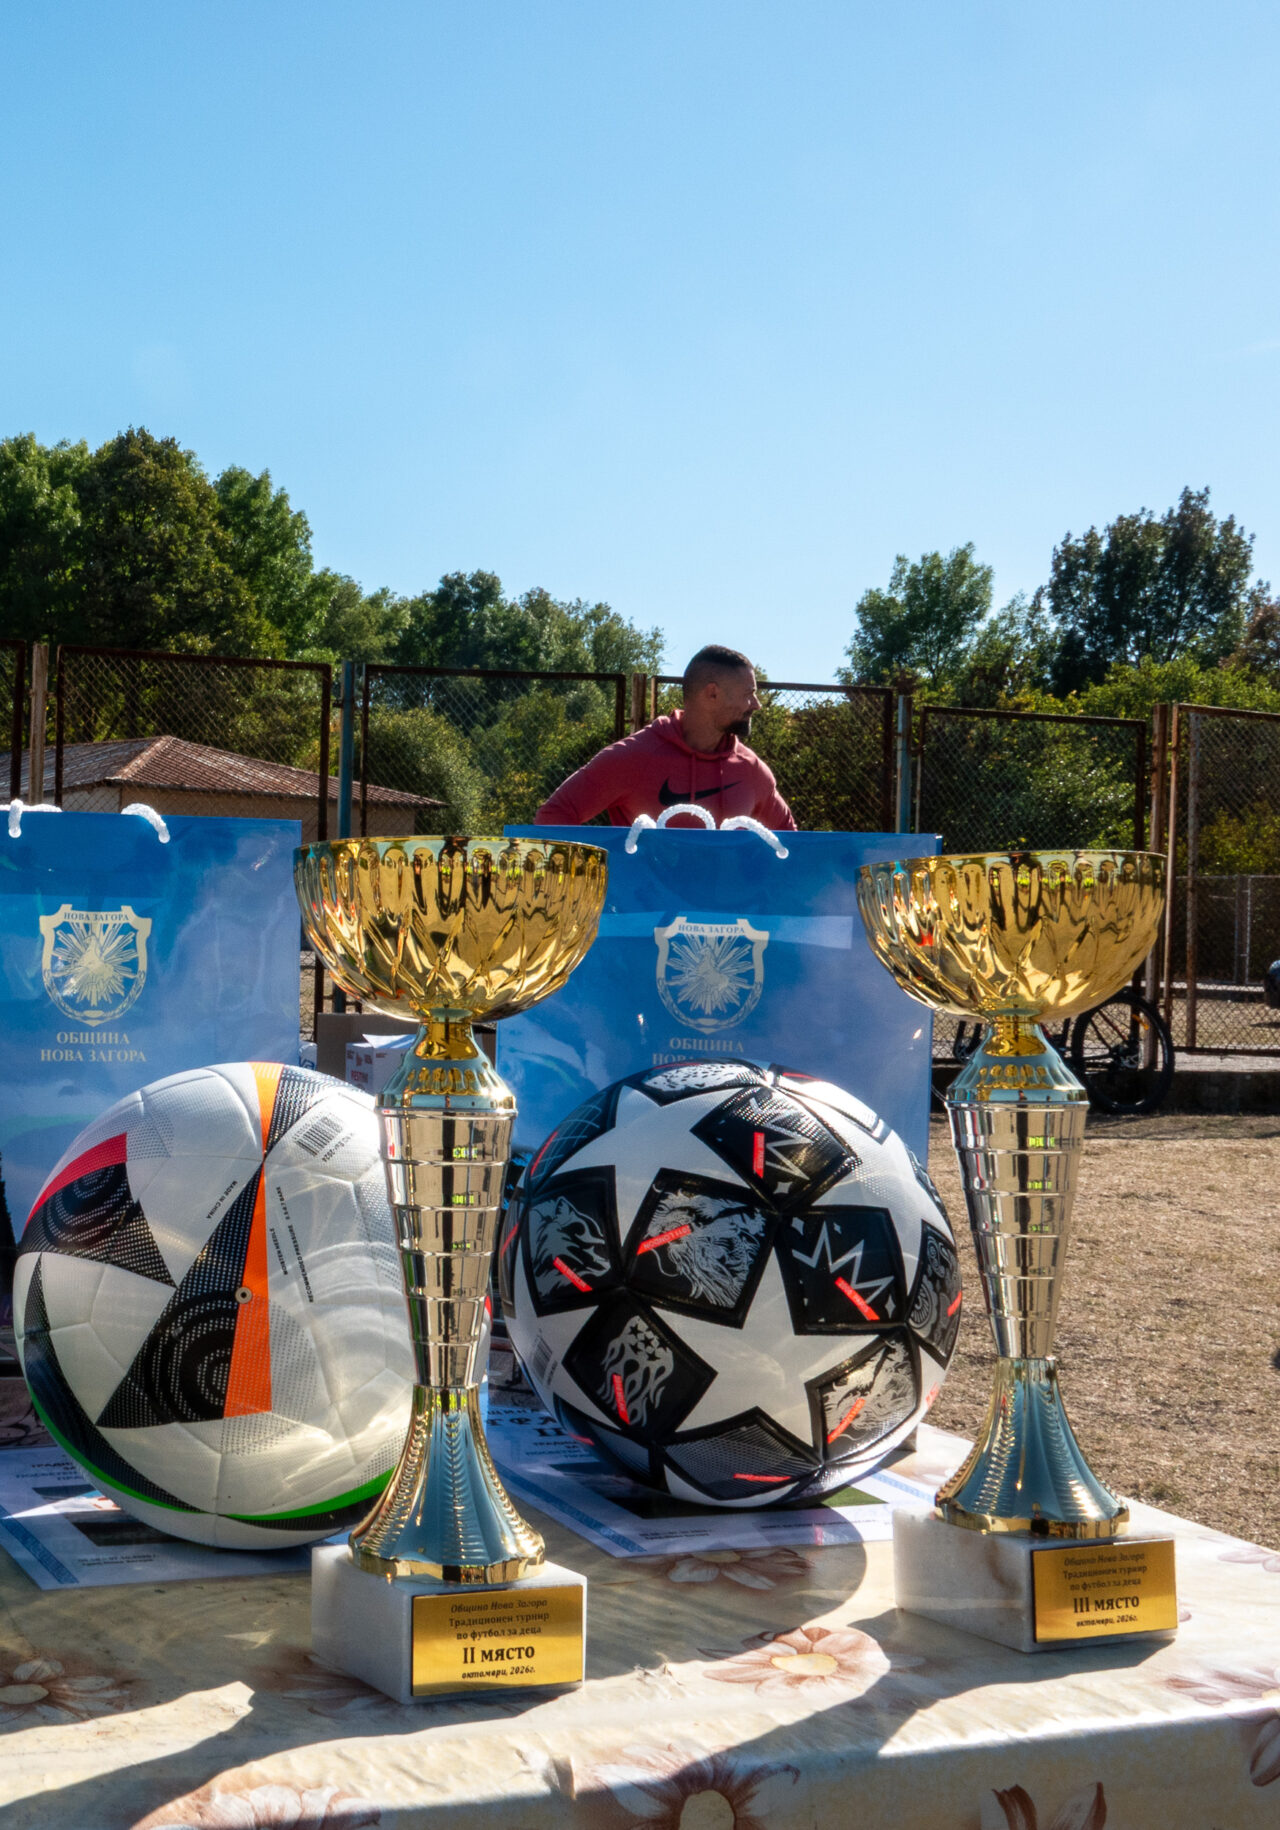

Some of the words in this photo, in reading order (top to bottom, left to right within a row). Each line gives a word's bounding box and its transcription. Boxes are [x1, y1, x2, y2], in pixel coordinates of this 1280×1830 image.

[64, 912, 90, 921] НОВА
[93, 913, 129, 921] ЗАГОРА
[678, 924, 705, 933] НОВА
[709, 925, 745, 934] ЗАГОРА
[56, 1031, 130, 1045] ОБЩИНА
[669, 1037, 744, 1053] ОБЩИНА
[40, 1048, 84, 1062] НОВА
[89, 1049, 147, 1063] ЗАГОРА
[490, 1601, 514, 1611] Нова
[1073, 1597, 1090, 1613] III
[449, 1614, 513, 1628] Традиционен
[515, 1612, 550, 1623] турнир
[456, 1632, 468, 1641] по
[470, 1628, 505, 1642] футбол
[507, 1628, 518, 1637] за
[519, 1627, 542, 1637] деца
[462, 1646, 475, 1664] II
[510, 1665, 536, 1676] 2026г.
